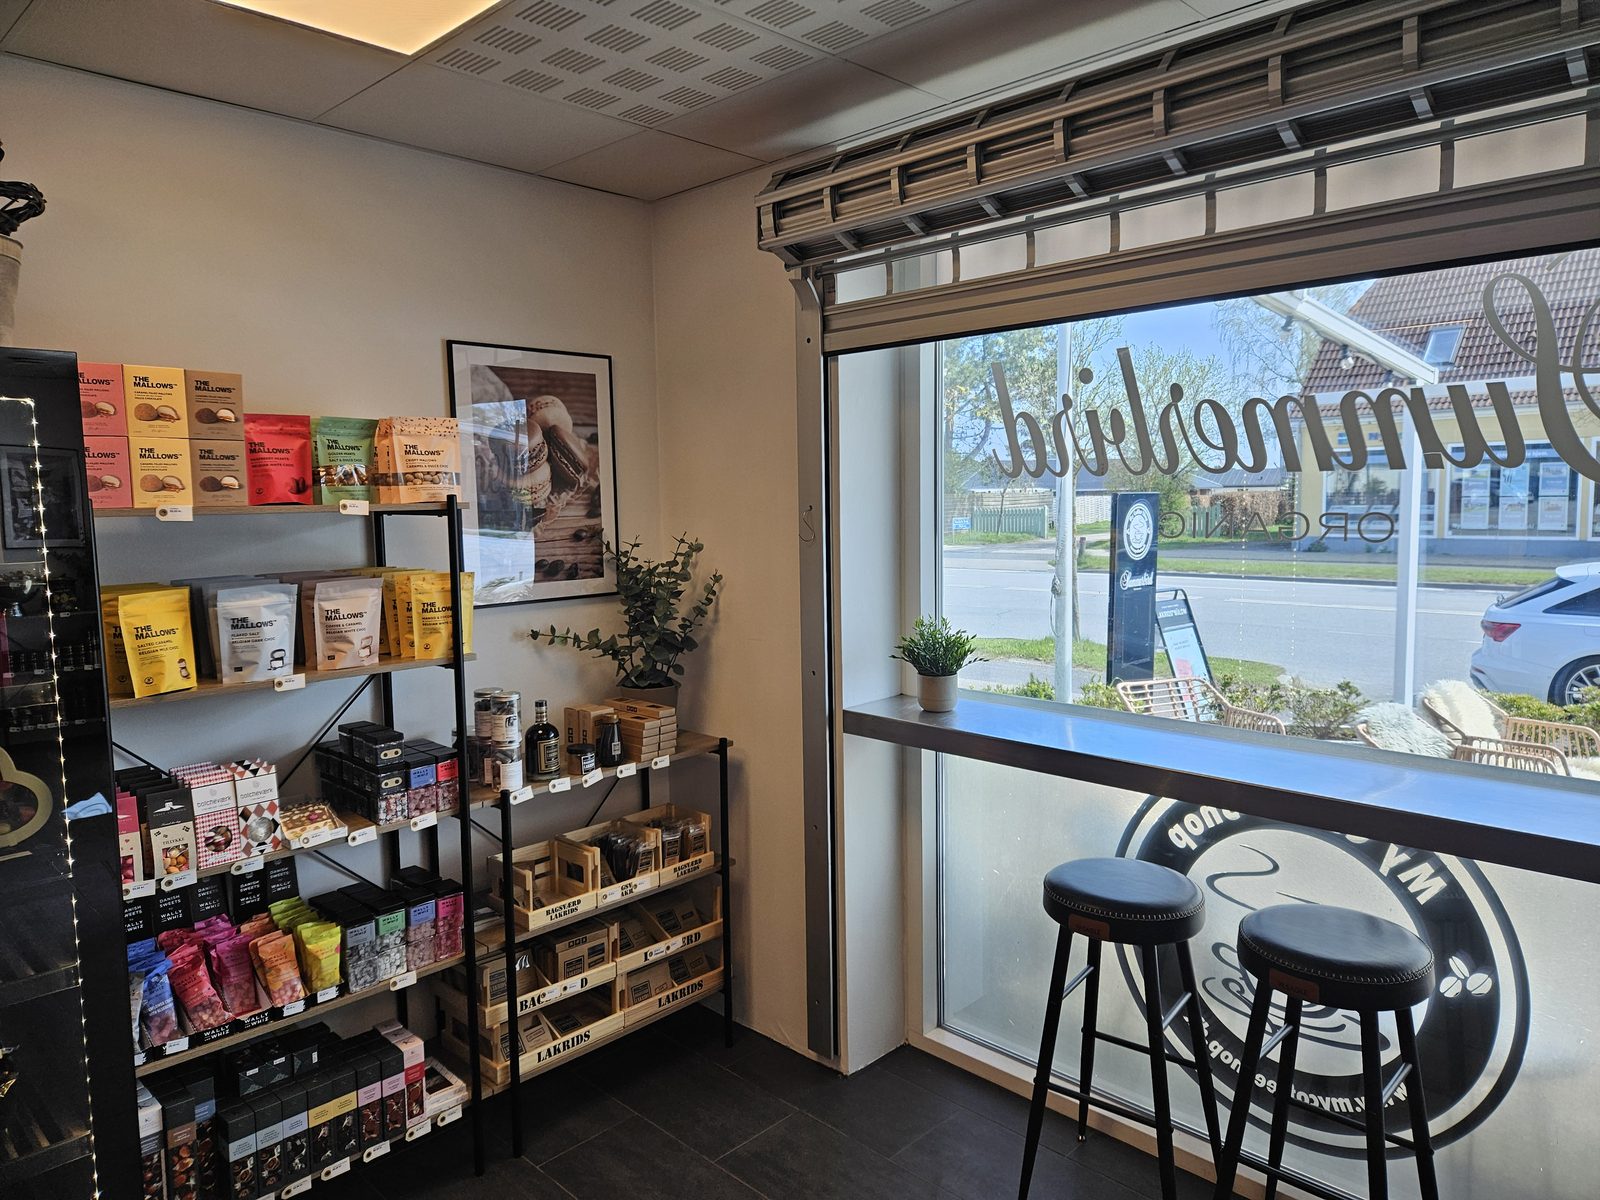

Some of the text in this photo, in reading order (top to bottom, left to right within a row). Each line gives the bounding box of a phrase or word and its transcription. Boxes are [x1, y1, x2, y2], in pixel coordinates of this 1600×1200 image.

[79, 378, 111, 386] ALLOWS
[325, 608, 341, 616] THE
[421, 605, 453, 614] MALLOW
[230, 616, 249, 625] THE
[133, 624, 152, 633] THE
[545, 898, 582, 916] BAGSVÆRD
[160, 909, 183, 918] WALLY
[166, 914, 183, 922] WHIZ
[549, 906, 579, 922] LAKRIDS
[124, 920, 144, 928] ALLY
[657, 980, 704, 1009] LAKRIDS
[244, 1012, 270, 1023] WALLY
[250, 1016, 270, 1026] WHIZ
[203, 1025, 230, 1037] WALLY
[211, 1030, 230, 1040] WHIZ
[536, 1030, 591, 1063] LAKRIDS
